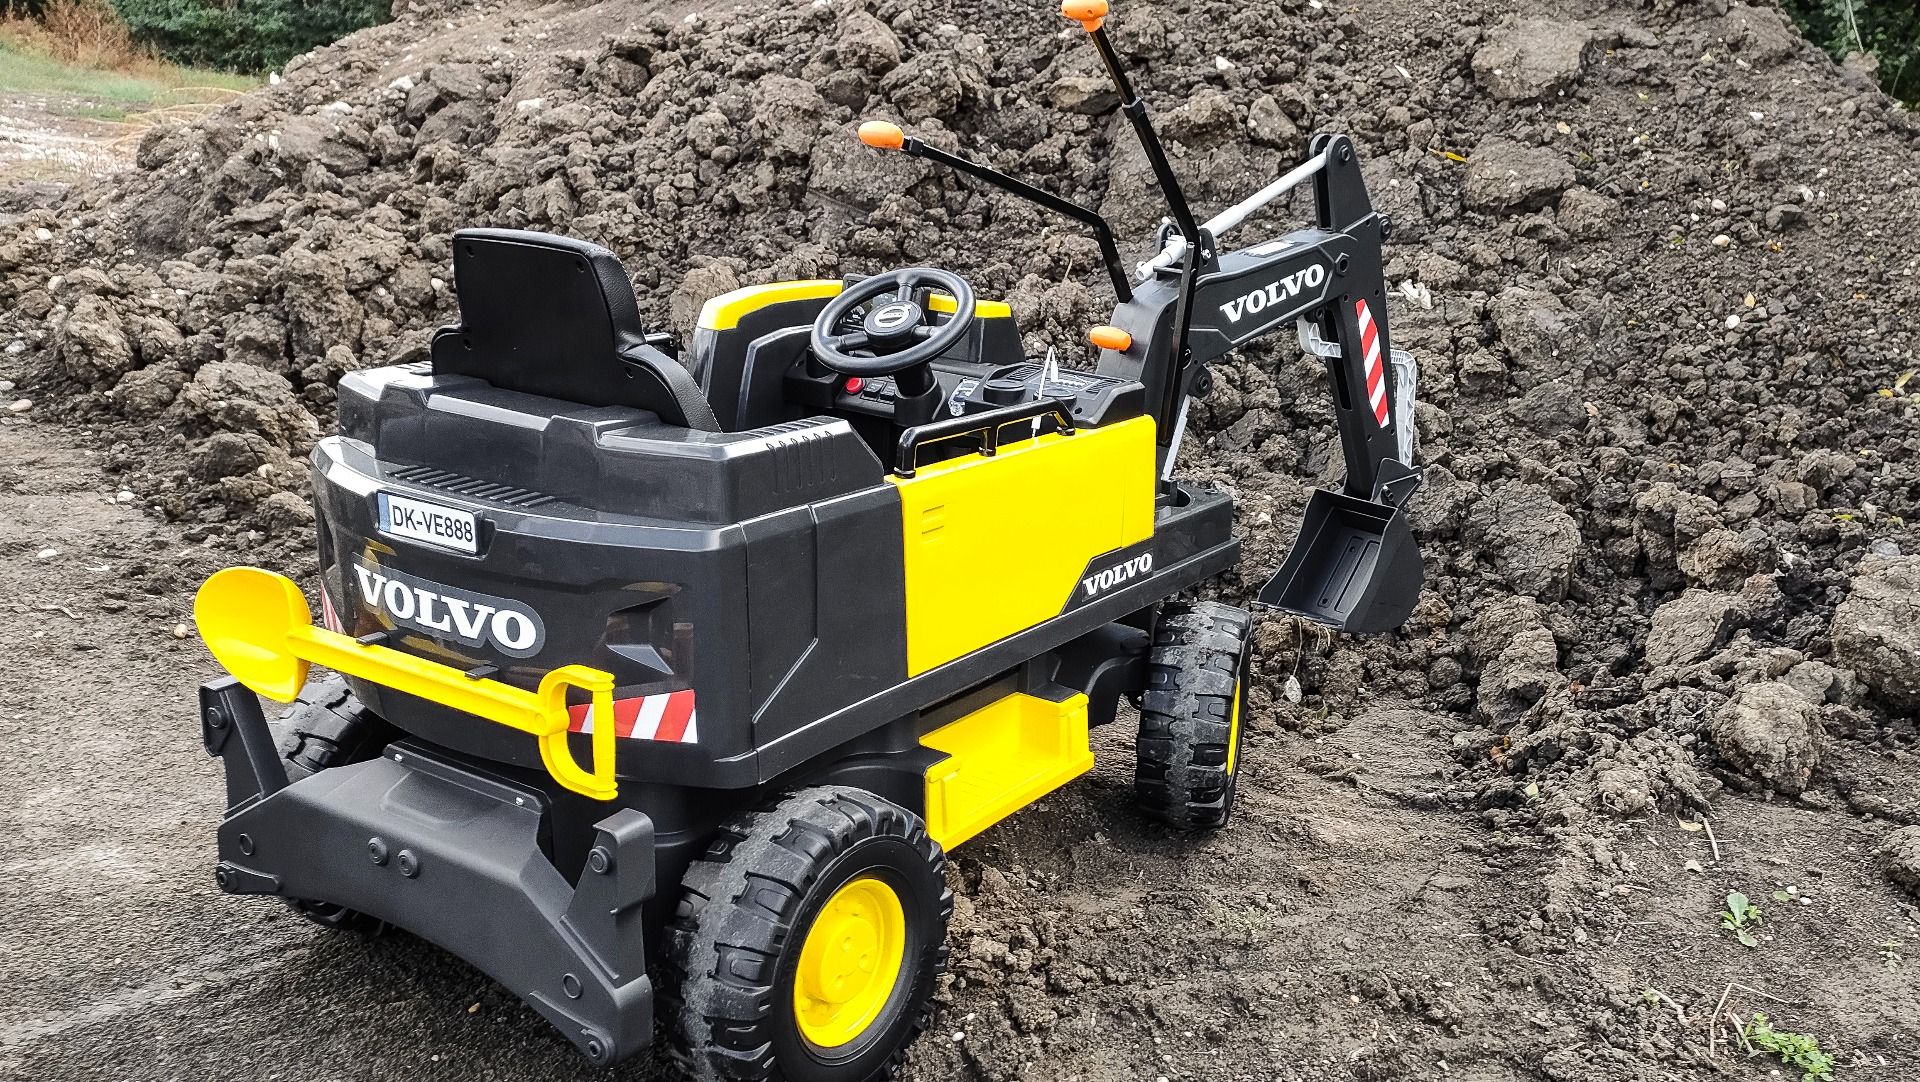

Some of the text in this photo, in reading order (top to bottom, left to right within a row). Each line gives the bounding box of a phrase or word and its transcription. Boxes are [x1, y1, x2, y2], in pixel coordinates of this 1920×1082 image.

[1219, 263, 1325, 323] VOLVO
[392, 504, 473, 542] DK-VE888
[1083, 552, 1153, 596] VOLVO
[353, 563, 537, 650] VOLVO
